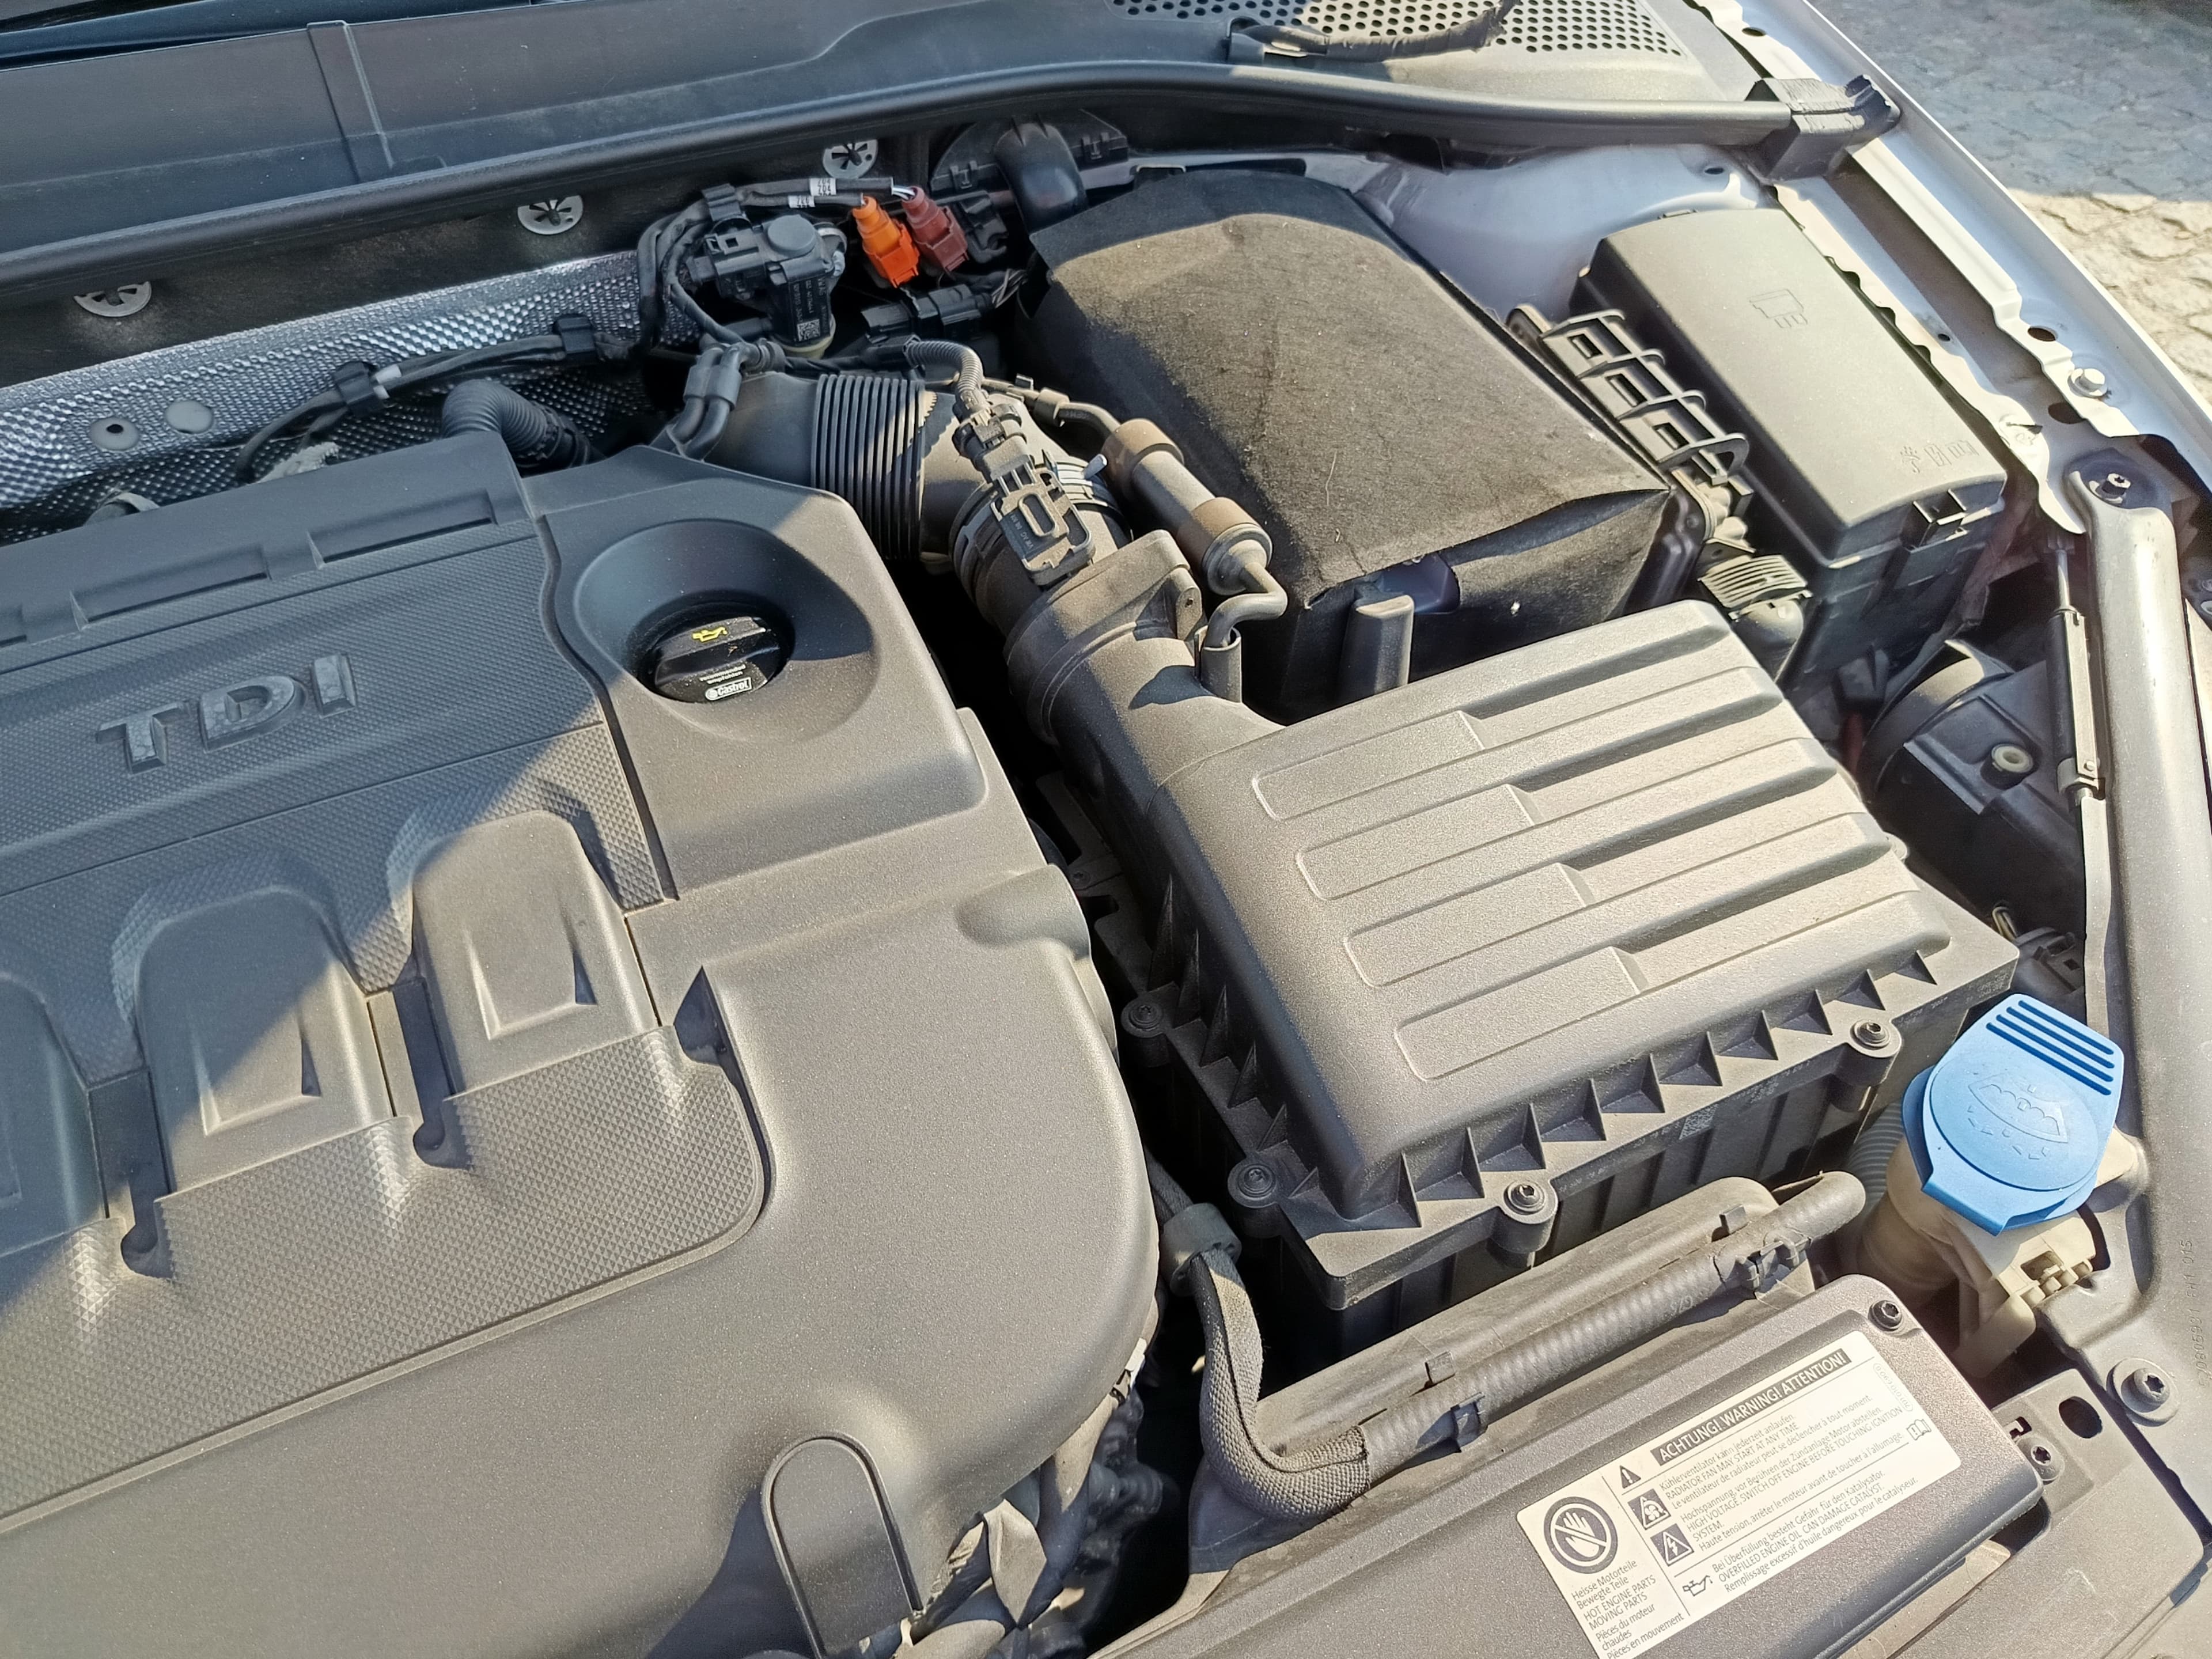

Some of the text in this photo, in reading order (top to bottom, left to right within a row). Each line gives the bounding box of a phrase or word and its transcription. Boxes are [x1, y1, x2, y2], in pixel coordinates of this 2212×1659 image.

[95, 653, 358, 775] TDI
[717, 680, 749, 696] Castrol
[1656, 1351, 1848, 1462] ACHTUNG! WARNING! ATTENTION!
[1658, 1455, 1717, 1491] Kühlerventilator
[1714, 1446, 1734, 1460] kann
[1732, 1429, 1765, 1452] jederzeit
[1665, 1475, 1703, 1500] RADIATOR
[1700, 1467, 1718, 1480] FAN
[1715, 1457, 1734, 1472] MAY
[1733, 1445, 1756, 1462] START
[1754, 1440, 1765, 1450] AT
[1764, 1431, 1781, 1445] ANY
[1671, 1499, 1682, 1509] Le
[1680, 1478, 1720, 1505] ventilateur
[1718, 1472, 1730, 1483] de
[1728, 1455, 1762, 1478] radiateur
[1760, 1446, 1779, 1462] peut
[1777, 1442, 1787, 1450] se
[1785, 1421, 1823, 1446] déclencher
[1826, 1410, 1843, 1423] tout
[1680, 1488, 1737, 1524] Hochspannung,
[1734, 1482, 1748, 1492] vor
[1745, 1463, 1780, 1486] Berühren
[1778, 1456, 1791, 1468] der
[1789, 1434, 1832, 1462] Zündanlage
[1828, 1423, 1851, 1439] Motor
[1685, 1406, 1903, 1532] HIGH VOLTAGE, SWITCH OFF ENGINE BEFORE TOUCHING IGNITION
[1691, 1519, 1725, 1541] SYSTEM.
[1698, 1533, 1723, 1551] Haute
[1721, 1517, 1752, 1539] tension,
[1749, 1503, 1775, 1522] arrêter
[1772, 1499, 1783, 1509] le
[1781, 1485, 1808, 1504] moteur
[1806, 1474, 1828, 1490] avant
[1826, 1468, 1838, 1479] de
[1834, 1453, 1863, 1473] toucher
[1711, 1469, 1886, 1573] Bei Überfüllung besteht Gefahr für den Katalysator.
[1717, 1482, 1885, 1582] OVERFILLED ENGINE OIL CAN DAMAGE CATALYST.
[1724, 1476, 1919, 1593] Remplissage excessif d'huile dangereux pour le catalyseur.
[1570, 1559, 1637, 1600] Heisse Motorteile
[1576, 1575, 1629, 1611] Bewegte Teile
[1583, 1574, 1657, 1621] HOT ENGINE PARTS
[1588, 1591, 1647, 1630] MOVING PARTS
[1594, 1603, 1656, 1642] Pièces du moteur
[1600, 1628, 1633, 1651] chaudes
[1606, 1612, 1684, 1659] Pièces en mouvement
